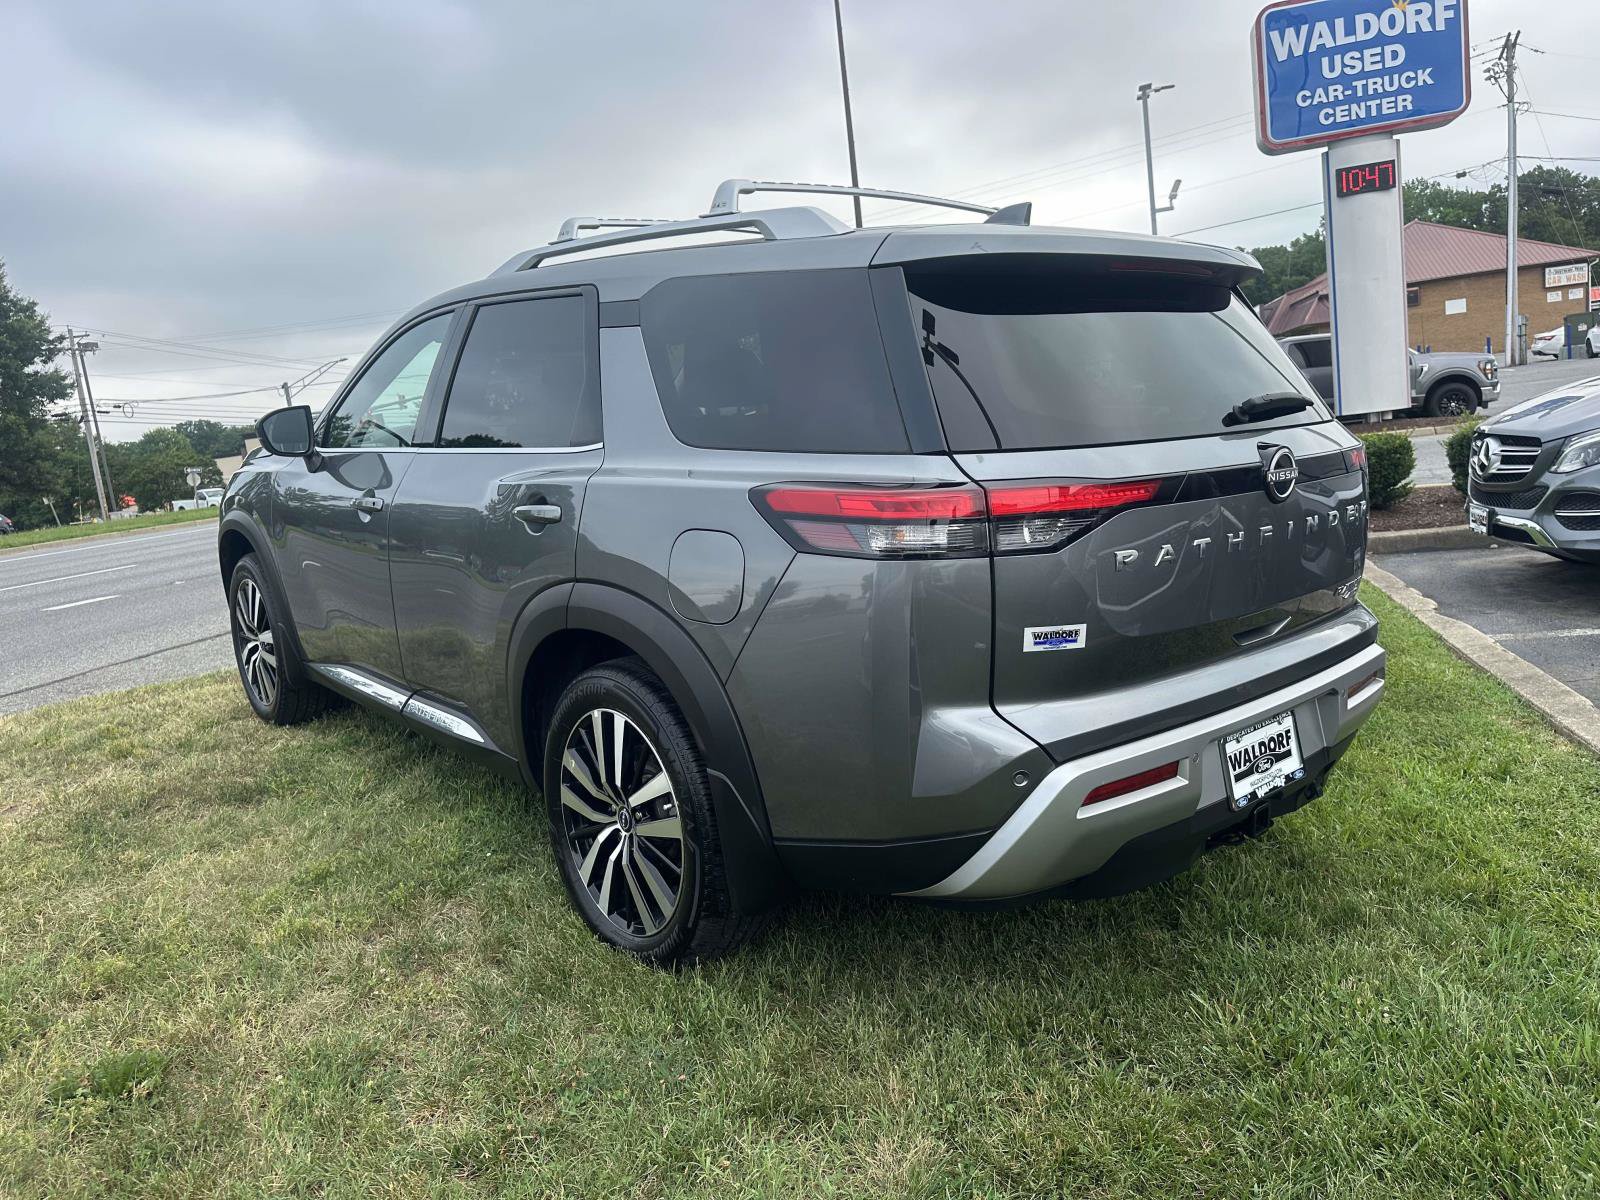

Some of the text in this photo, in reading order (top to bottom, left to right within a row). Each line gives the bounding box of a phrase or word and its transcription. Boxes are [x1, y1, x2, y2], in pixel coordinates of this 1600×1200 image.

[1269, 0, 1457, 63] WALDORF
[1321, 43, 1407, 80] USED
[1295, 67, 1435, 108] CAR-TRUCK
[1318, 94, 1414, 126] CENTER
[1341, 163, 1394, 193] 10:47
[1547, 272, 1586, 286] CAR WASH
[1268, 470, 1298, 481] NISSAN
[1114, 500, 1367, 572] PATHFINDER
[1031, 628, 1080, 641] WALDORF
[1227, 728, 1292, 772] WALDORF
[1255, 775, 1286, 798] WALDORF
